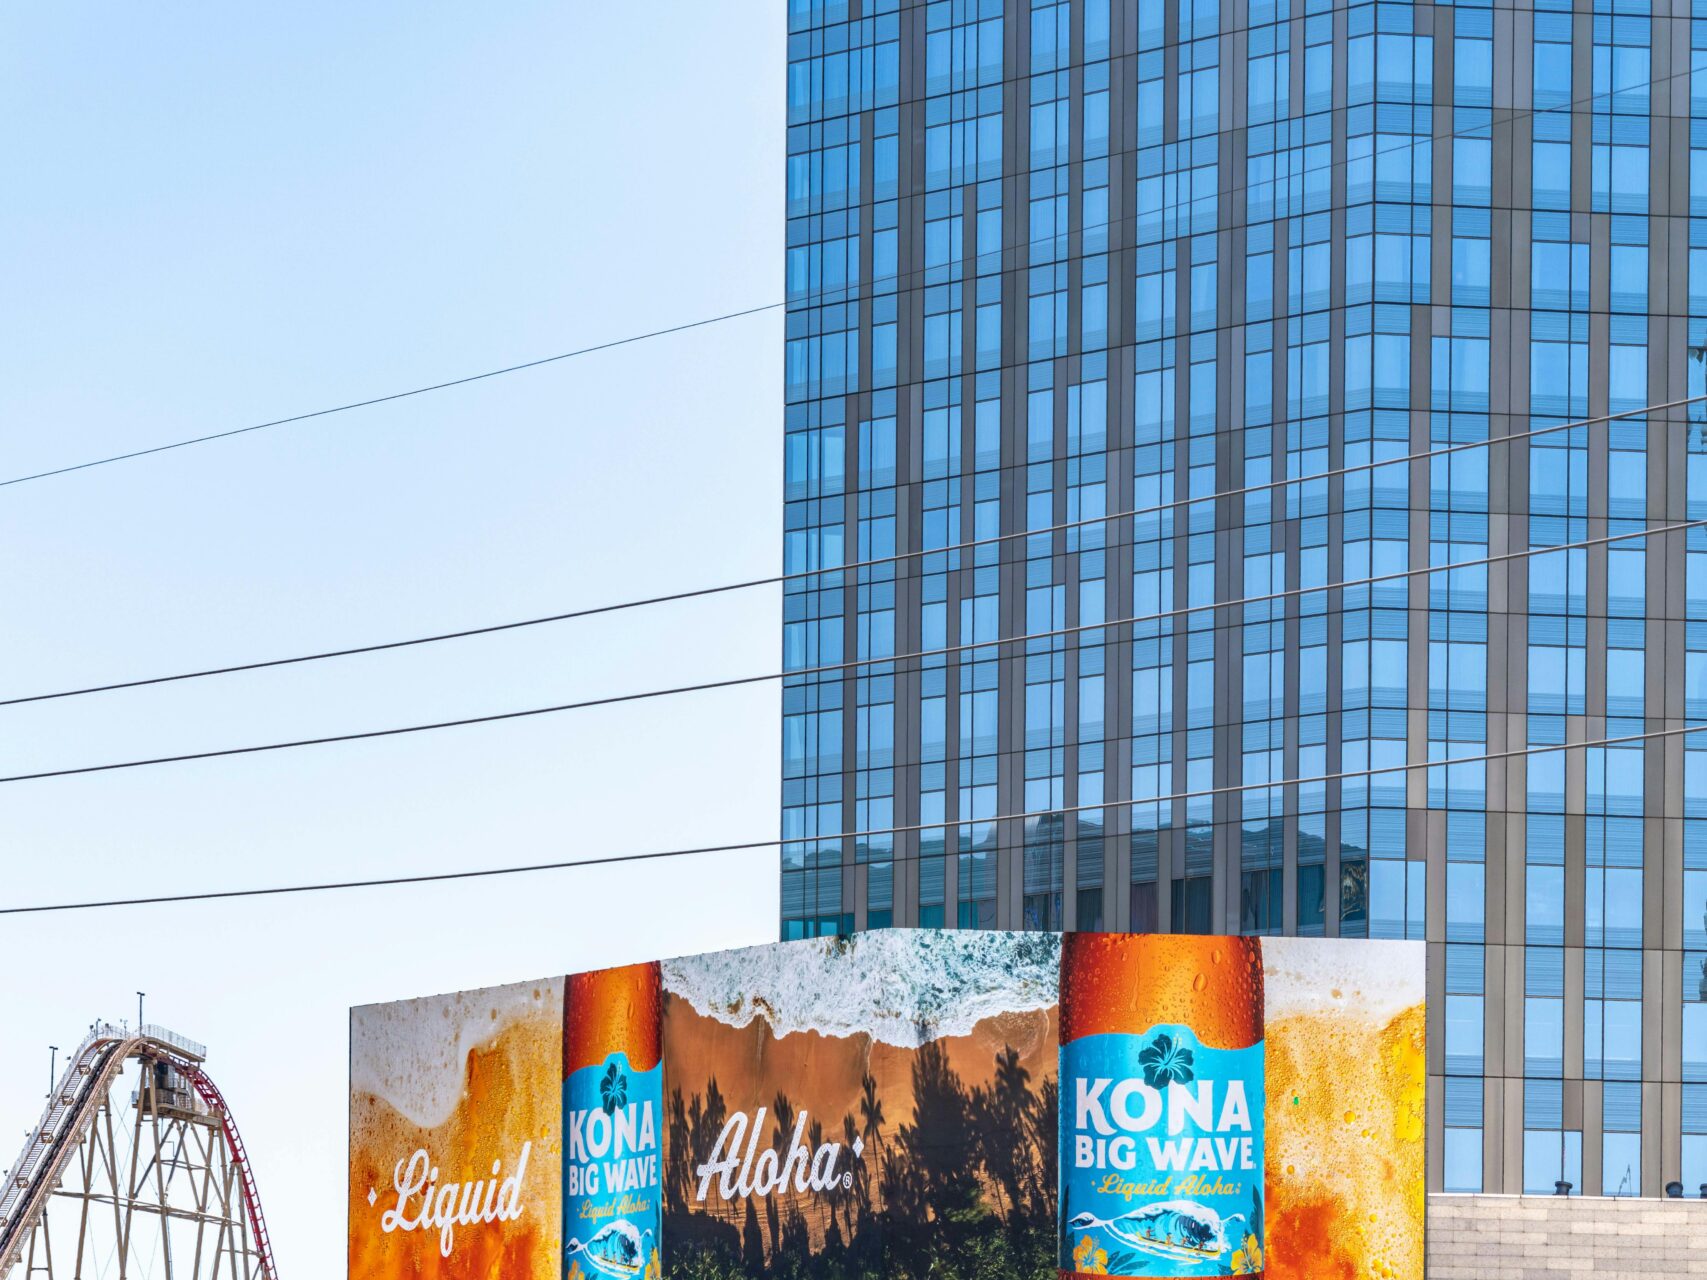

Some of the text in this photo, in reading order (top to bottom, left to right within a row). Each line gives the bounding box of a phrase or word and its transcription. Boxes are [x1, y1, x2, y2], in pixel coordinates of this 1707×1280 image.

[1075, 1077, 1252, 1136] KONA
[569, 1100, 656, 1163] KONA
[1075, 1135, 1257, 1171] BIG WAVE
[569, 1153, 658, 1197] BIG WAVE
[1097, 1173, 1170, 1201] Liquid
[380, 1141, 532, 1258] Liquid
[579, 1199, 615, 1224] Liquid
